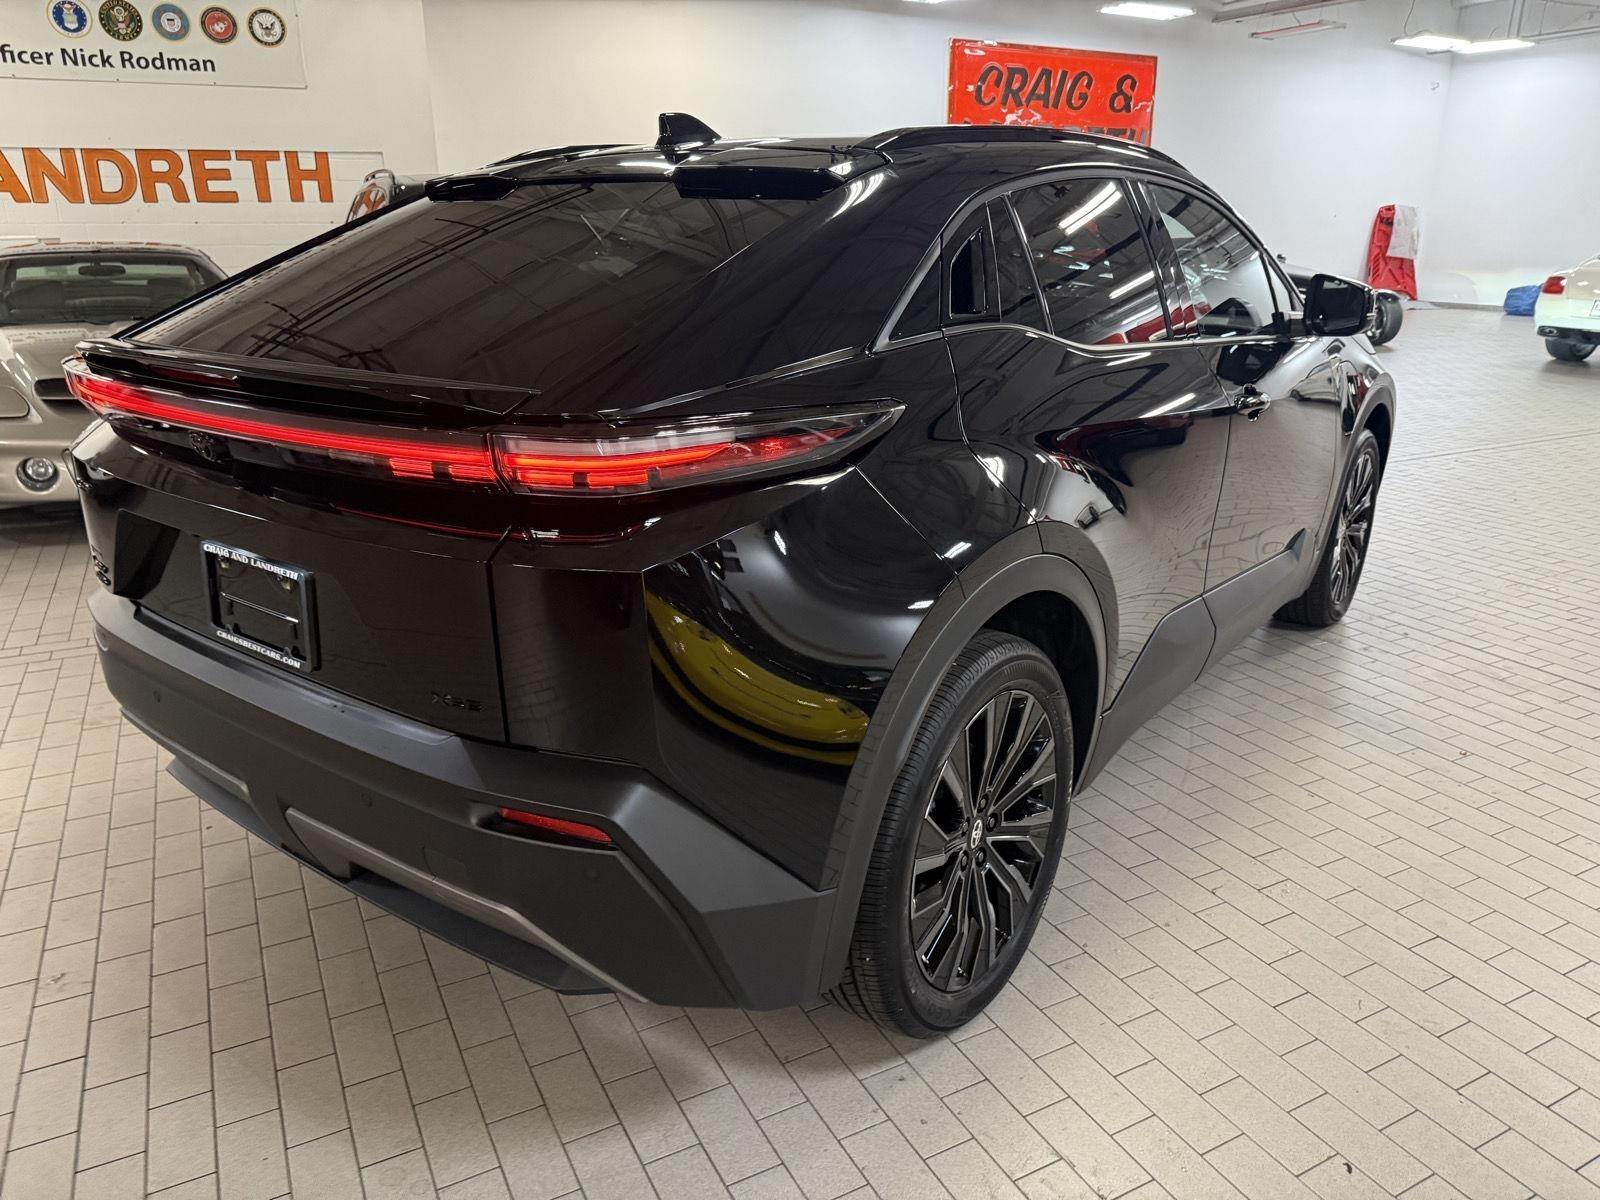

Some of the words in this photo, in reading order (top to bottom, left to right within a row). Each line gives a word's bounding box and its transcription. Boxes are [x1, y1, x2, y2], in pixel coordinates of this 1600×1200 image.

[60, 47, 116, 69] Nick
[120, 50, 217, 73] Rodman
[973, 63, 1094, 112] CRAIG
[1108, 73, 1138, 113] &
[202, 543, 230, 558] CRAIG
[230, 552, 249, 564] AND
[249, 558, 299, 581] LANDRETH
[216, 630, 301, 669] CRAIGSBESTCARS.COM
